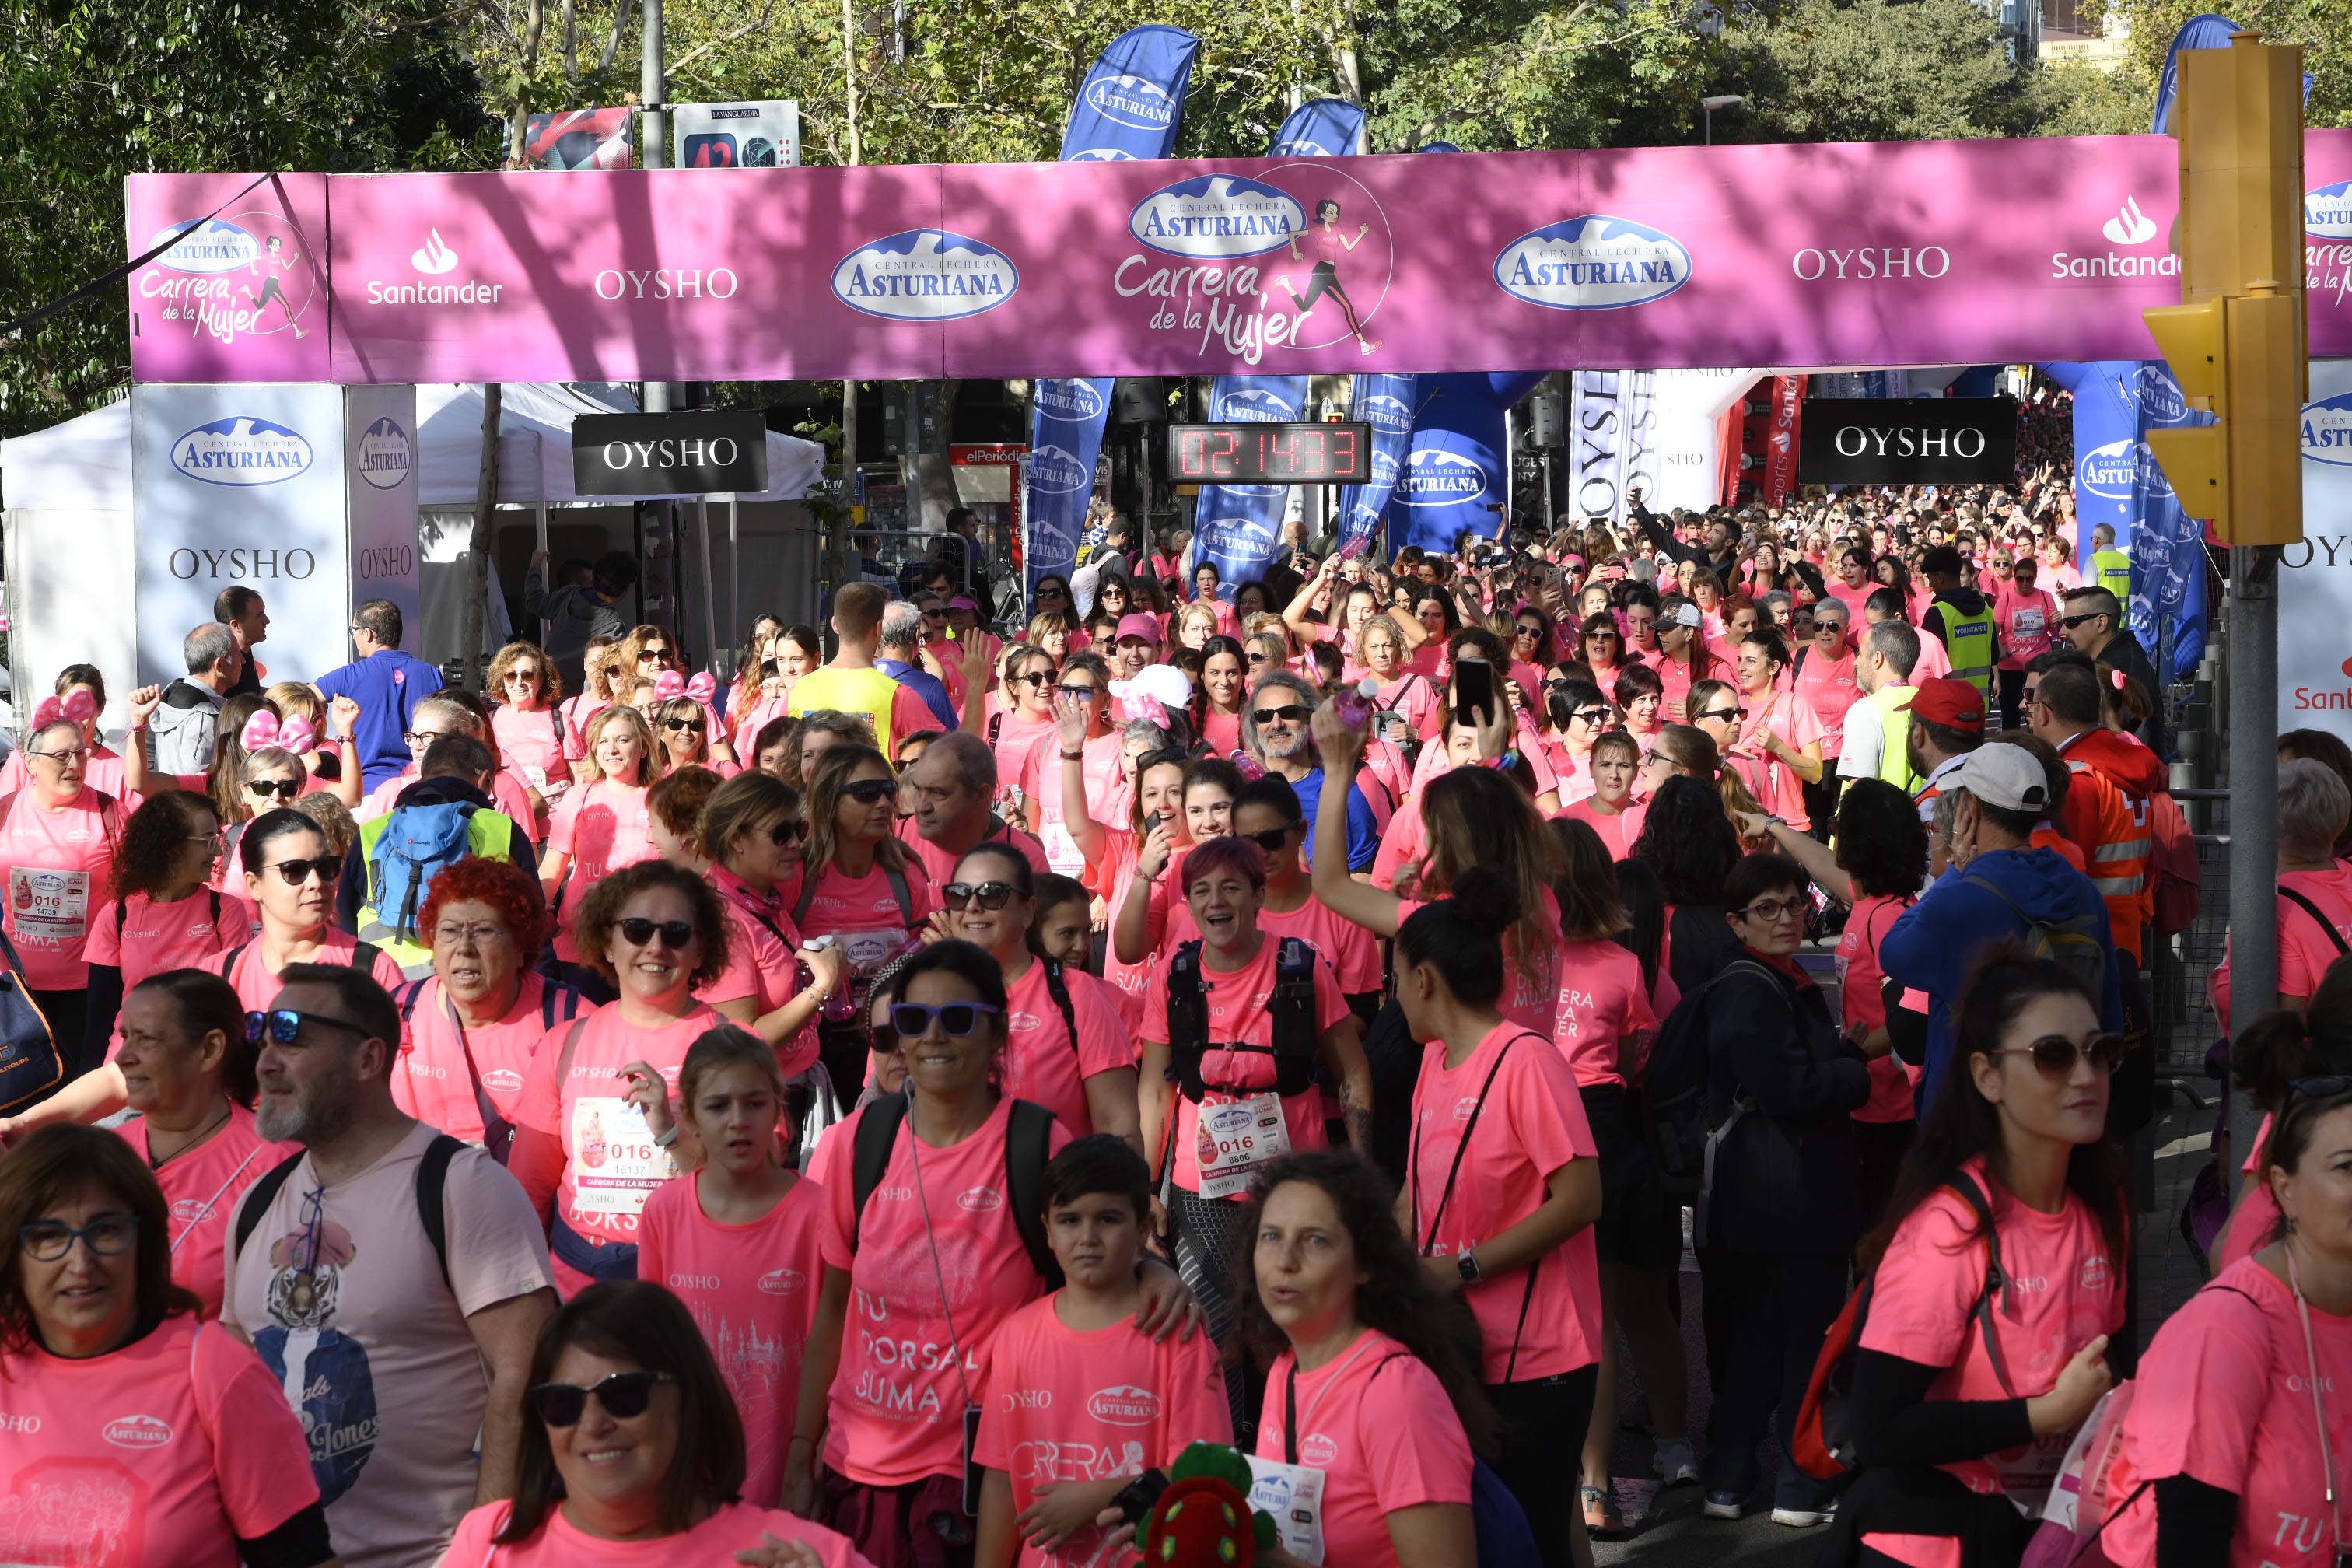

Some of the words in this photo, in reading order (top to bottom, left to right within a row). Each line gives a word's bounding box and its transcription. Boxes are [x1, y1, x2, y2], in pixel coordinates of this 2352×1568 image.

[1092, 85, 1171, 124] ASTURIANA
[1170, 202, 1225, 212] CENTRAL
[1231, 201, 1287, 212] LECHERA
[1143, 206, 1291, 237] ASTURIANA
[1539, 247, 1601, 258] CENTRAL
[1608, 246, 1670, 257] LECHERA
[1793, 246, 1950, 281] OYSHO
[874, 261, 933, 271] CENTRAL
[939, 259, 998, 269] LECHERA
[1115, 255, 1258, 298] Carrera
[1509, 252, 1676, 287] ASTURIANA
[2052, 252, 2182, 278] Santand
[140, 269, 230, 299] Carrera
[595, 268, 737, 300] OYSHO
[847, 264, 1004, 297] ASTURIANA
[2324, 268, 2338, 289] la
[368, 280, 502, 304] Santander
[162, 302, 179, 320] de
[183, 299, 194, 320] la
[193, 296, 266, 344] Mujer
[1150, 303, 1175, 330] de
[1183, 300, 1202, 330] la
[1199, 292, 1313, 365] Mujer
[1034, 385, 1094, 414] ASTURIANA
[1359, 409, 1409, 429] ASTURIANA
[604, 436, 738, 470] OYSHO
[1835, 426, 1985, 458] OYSHO
[182, 443, 303, 468] ASTURIANA
[362, 444, 408, 471] ASTURIANA
[1205, 532, 1270, 556] ASTURIANA
[2280, 535, 2352, 568] OY
[169, 548, 316, 579] OYSHO
[360, 544, 411, 579] OYSHO
[586, 862, 602, 877] TU
[34, 895, 61, 906] 016
[124, 929, 160, 939] OYSHO
[1559, 989, 1594, 1009] ERA
[1557, 1020, 1578, 1038] ER
[572, 1066, 617, 1080] OYSHO
[1213, 1115, 1250, 1130] ASTURIANA
[611, 1144, 652, 1160] 016
[1220, 1136, 1254, 1153] 016
[615, 1165, 646, 1175] 16137
[1229, 1153, 1250, 1164] 8806
[586, 1178, 614, 1187] CARRERA
[1206, 1168, 1230, 1178] CARRERA
[1207, 1180, 1234, 1192] OYSHO
[585, 1194, 614, 1204] OYSHO
[670, 1273, 721, 1290] OYSHO
[856, 1288, 887, 1321] TU
[856, 1369, 940, 1412] SUMA
[108, 1426, 168, 1442] ASTURIANA
[2273, 1511, 2324, 1552] TU
